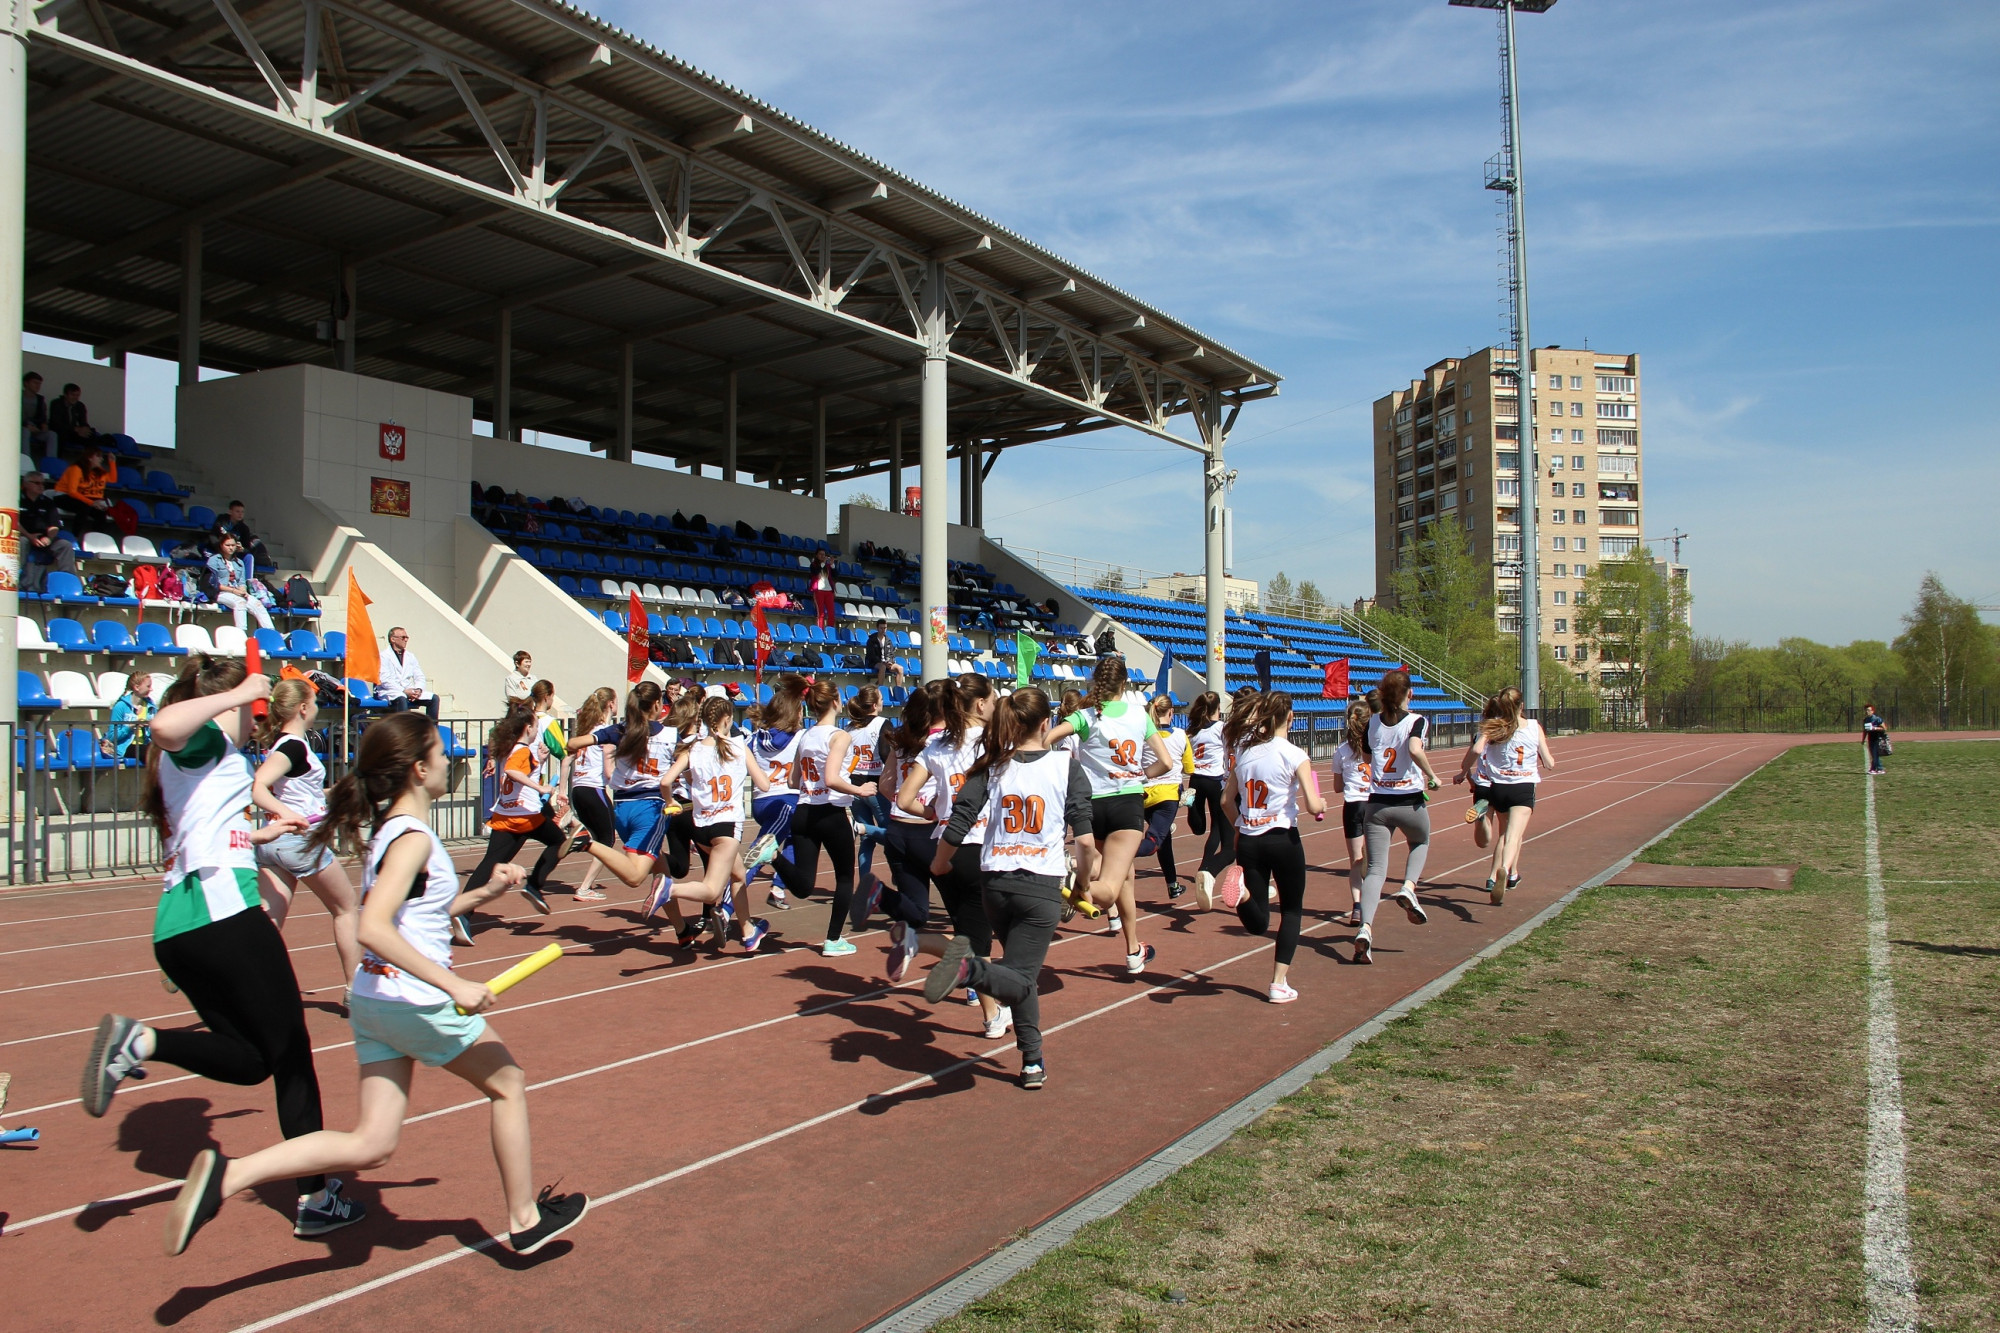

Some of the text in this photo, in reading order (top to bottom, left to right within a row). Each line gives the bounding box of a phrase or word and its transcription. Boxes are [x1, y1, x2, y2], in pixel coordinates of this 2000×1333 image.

[1108, 738, 1138, 767] 32
[1383, 747, 1397, 773] 2
[1515, 745, 1524, 766] 1
[769, 760, 794, 783] 21
[801, 756, 820, 783] 15
[707, 774, 733, 803] 13
[1245, 778, 1269, 810] 12
[1001, 793, 1046, 835] 30
[335, 1199, 352, 1219] N
